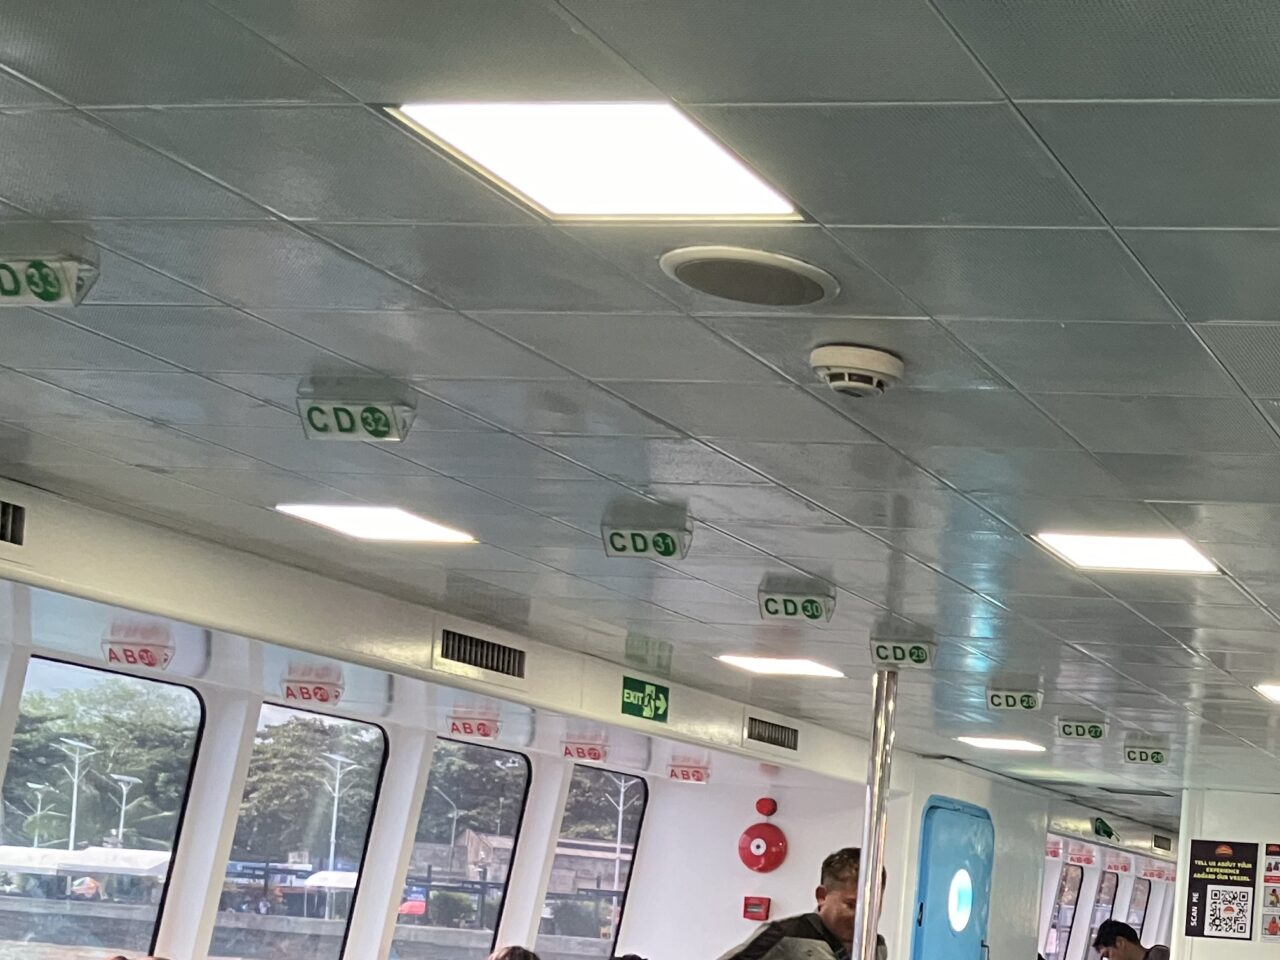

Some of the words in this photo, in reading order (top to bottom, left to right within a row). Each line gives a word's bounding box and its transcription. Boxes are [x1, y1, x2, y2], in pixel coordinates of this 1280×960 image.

[361, 411, 389, 432] 32
[653, 535, 675, 553] 31
[803, 601, 821, 617] 30
[910, 647, 927, 661] 29
[623, 688, 644, 705] EXIT
[1020, 696, 1036, 708] 28
[1088, 726, 1102, 738] 27
[1151, 752, 1164, 763] 26
[1192, 892, 1199, 903] ME
[1190, 906, 1198, 927] SCAN
